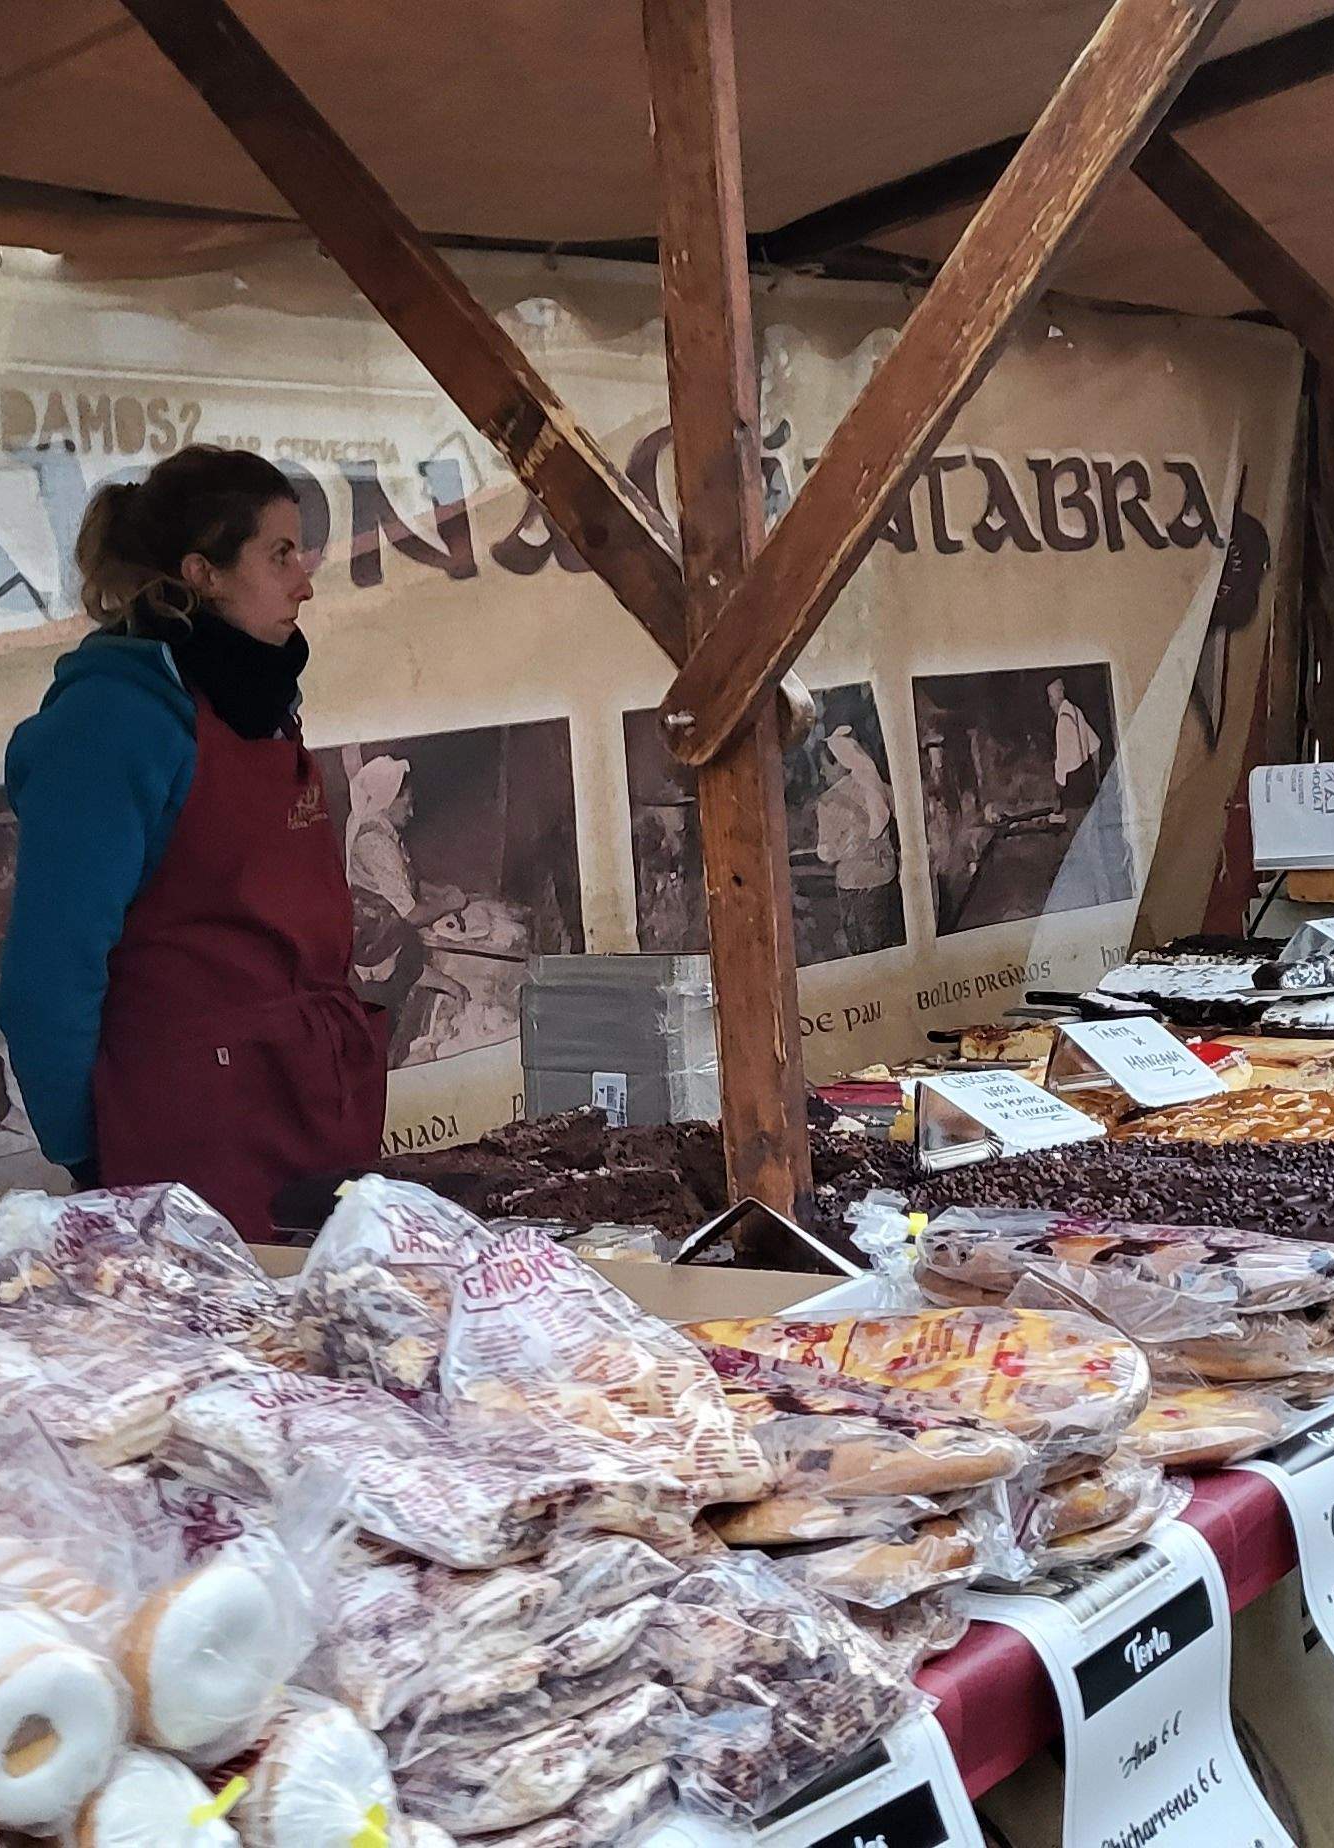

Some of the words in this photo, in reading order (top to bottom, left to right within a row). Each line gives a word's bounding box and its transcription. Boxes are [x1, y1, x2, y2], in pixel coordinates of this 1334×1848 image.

[624, 418, 1225, 555] CTABRA
[917, 980, 971, 1011] BOLLOS
[842, 999, 883, 1032] PAN
[1088, 1024, 1137, 1043] TARTA
[1123, 1050, 1185, 1071] MANZANA
[1161, 1719, 1170, 1746] 6
[1197, 1766, 1210, 1794] 6
